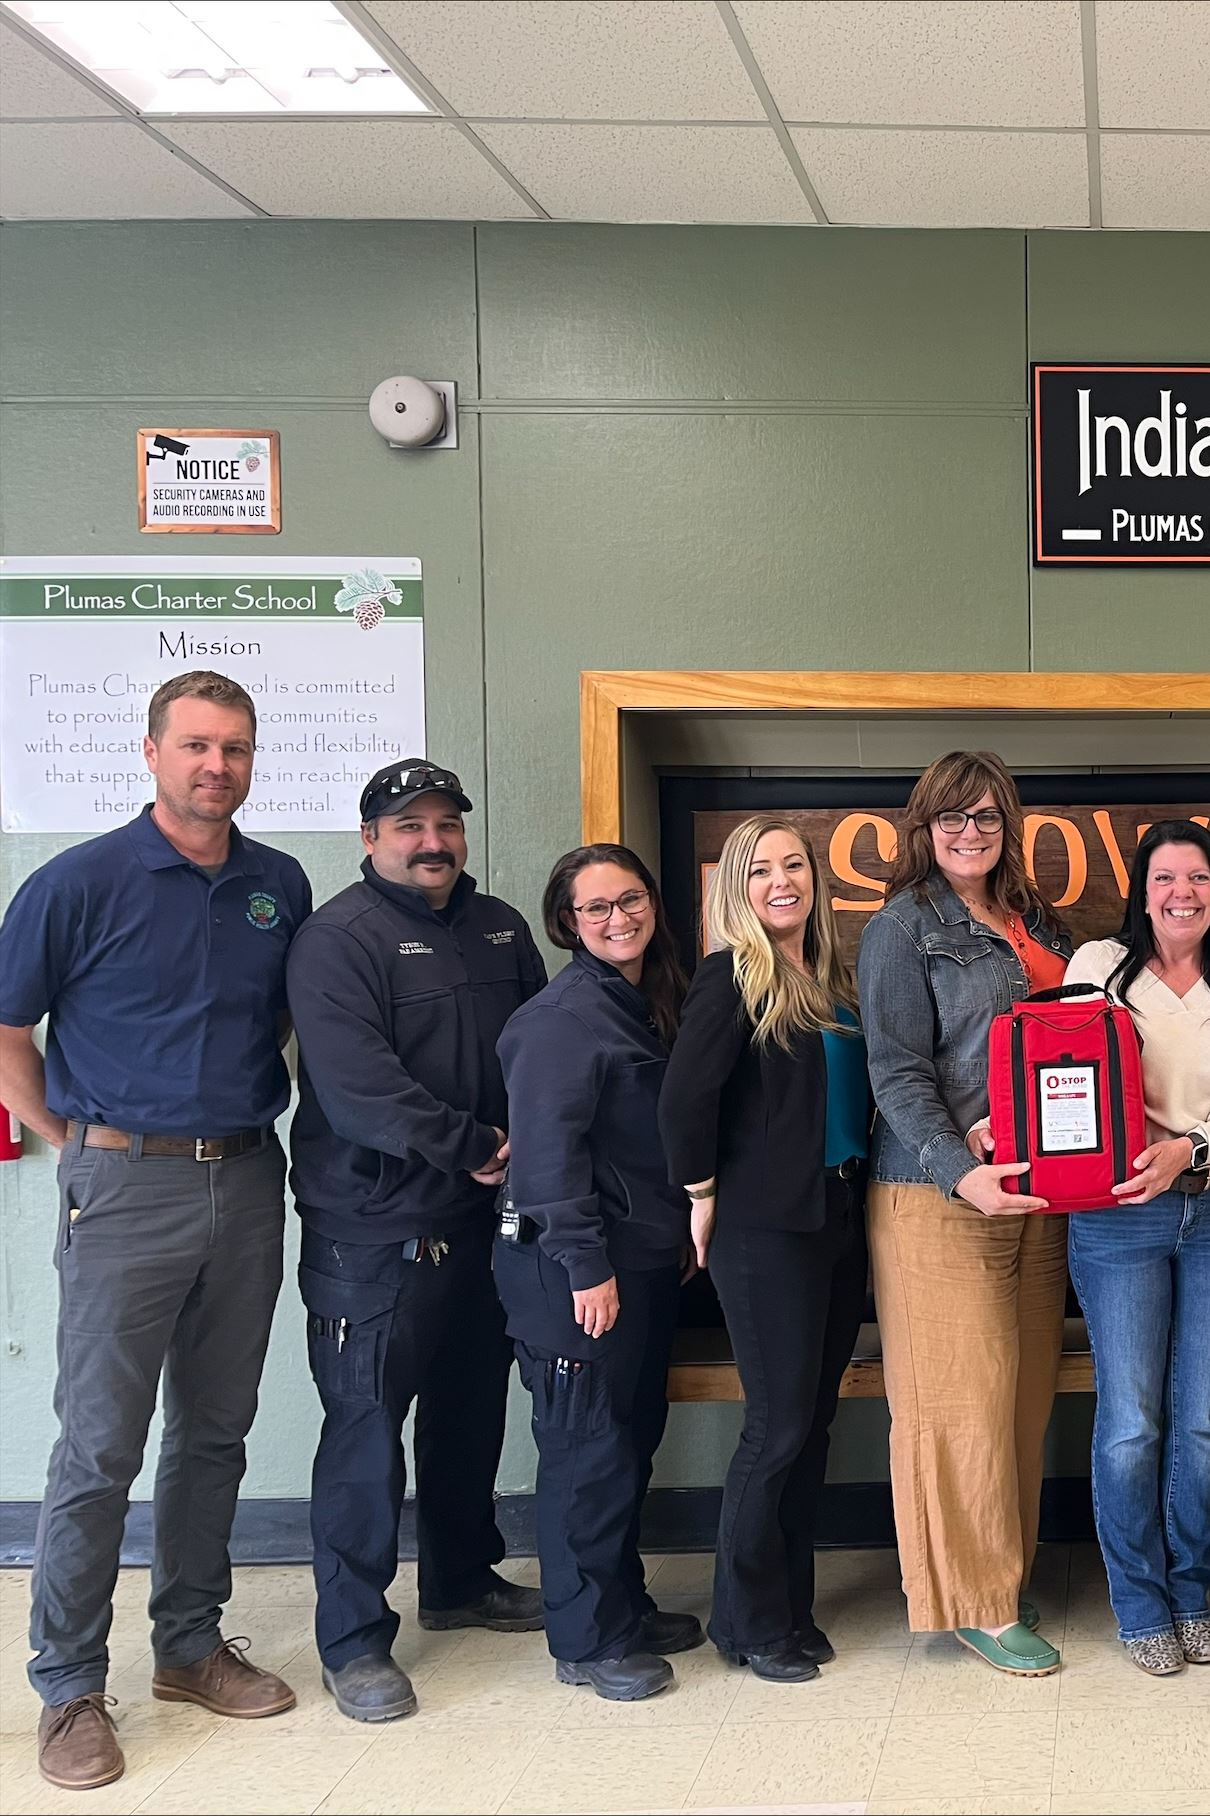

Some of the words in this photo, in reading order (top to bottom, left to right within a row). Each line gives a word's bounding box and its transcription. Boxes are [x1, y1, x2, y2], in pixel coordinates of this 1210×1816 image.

[176, 459, 241, 480] NOTICE
[153, 488, 197, 501] SECURITY
[199, 489, 244, 501] CAMERAS
[246, 489, 265, 501] AND
[153, 504, 180, 517] AUDIO
[182, 504, 234, 517] RECORDING
[236, 505, 246, 517] IN
[248, 505, 266, 517] USE
[1112, 508, 1204, 542] PLUMAS
[44, 584, 126, 610] Plumas
[131, 584, 227, 611] Charter
[231, 584, 317, 611] School
[159, 631, 261, 659] Mission
[29, 673, 97, 697] Plumas
[103, 673, 164, 697] Chart
[274, 678, 289, 694] is
[295, 674, 395, 694] committed
[48, 709, 67, 724] to
[258, 707, 378, 724] communities
[24, 733, 63, 753] with
[271, 733, 307, 753] and
[314, 732, 401, 760] flexibility
[45, 763, 85, 784] that
[90, 772, 156, 792] suppo
[277, 767, 293, 783] in
[300, 762, 370, 783] reachin
[95, 792, 139, 813] their
[242, 792, 335, 821] potential.
[1061, 1076, 1087, 1085] STOP
